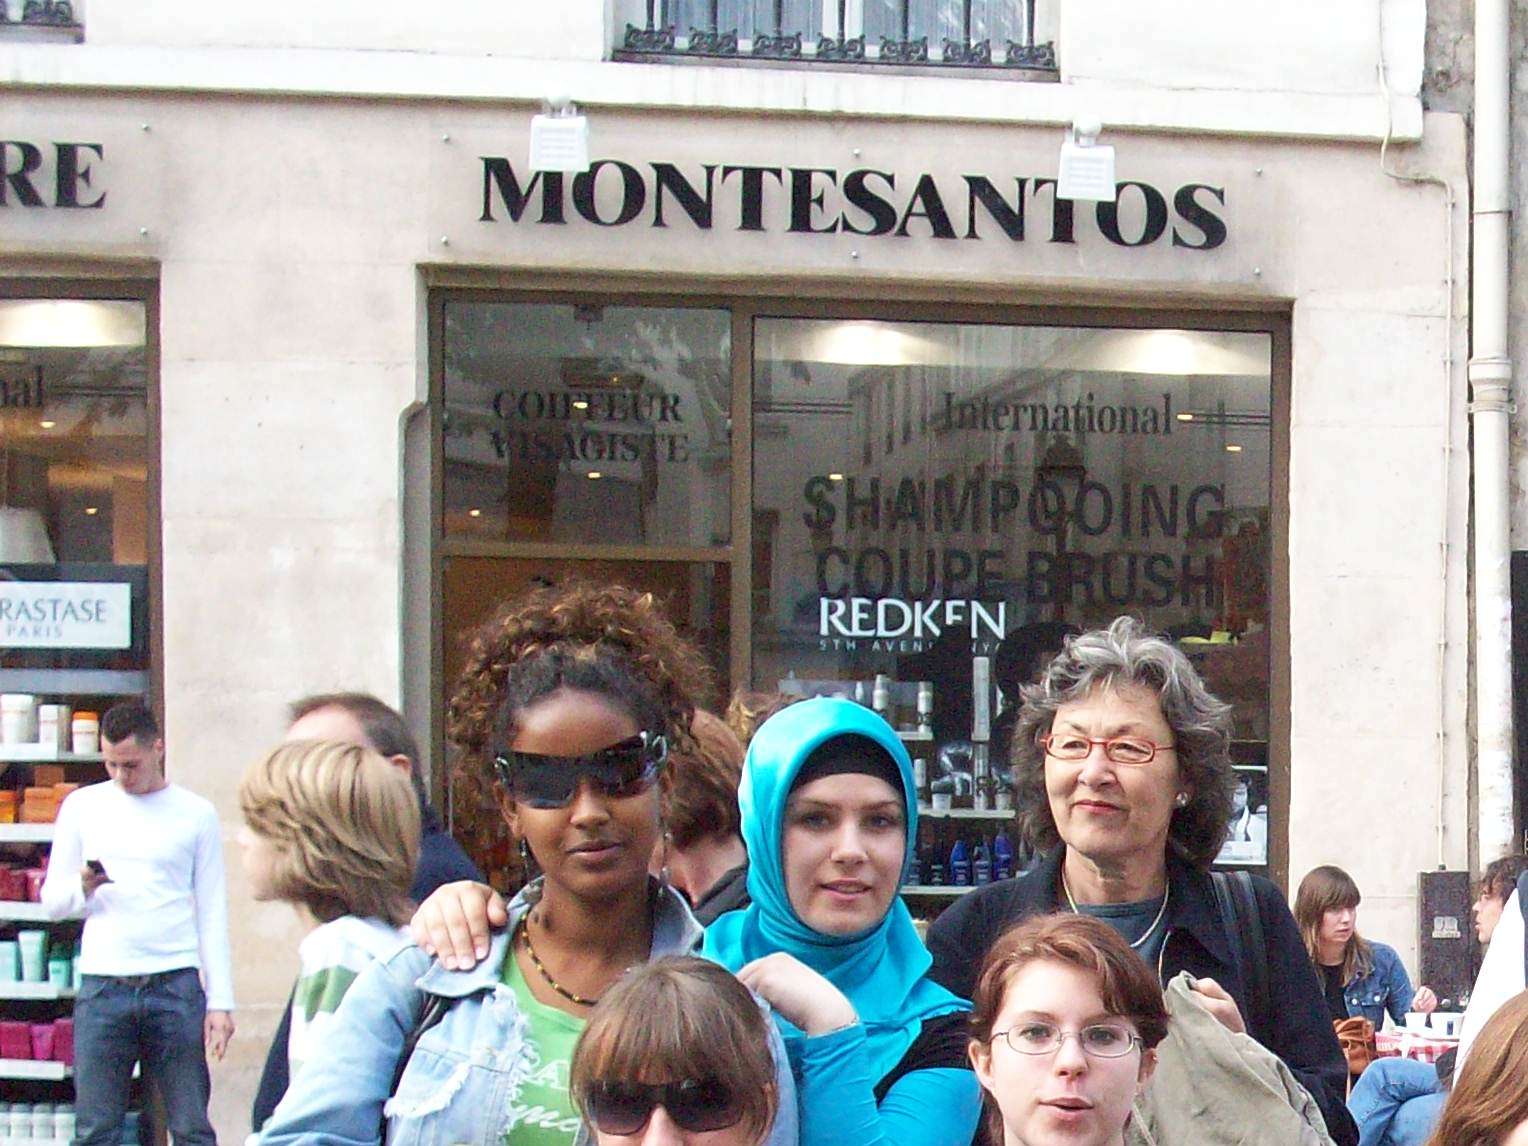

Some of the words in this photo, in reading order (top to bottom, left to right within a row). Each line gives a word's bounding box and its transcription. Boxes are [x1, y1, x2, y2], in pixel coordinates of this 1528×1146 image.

[0, 141, 106, 208] RE
[479, 157, 1228, 250] MONTESANTOS
[493, 390, 684, 422] COIFFEUR
[941, 391, 1173, 435] International
[490, 430, 690, 463] VISAGISTE
[803, 475, 1225, 540] SHAMPOOING
[816, 546, 1005, 602] COUPE
[1026, 550, 1218, 607] BRUSH
[0, 598, 106, 623] RASTASE
[7, 624, 63, 638] PARIS
[819, 597, 1006, 640] REDKEN
[871, 639, 933, 652] AVEN
